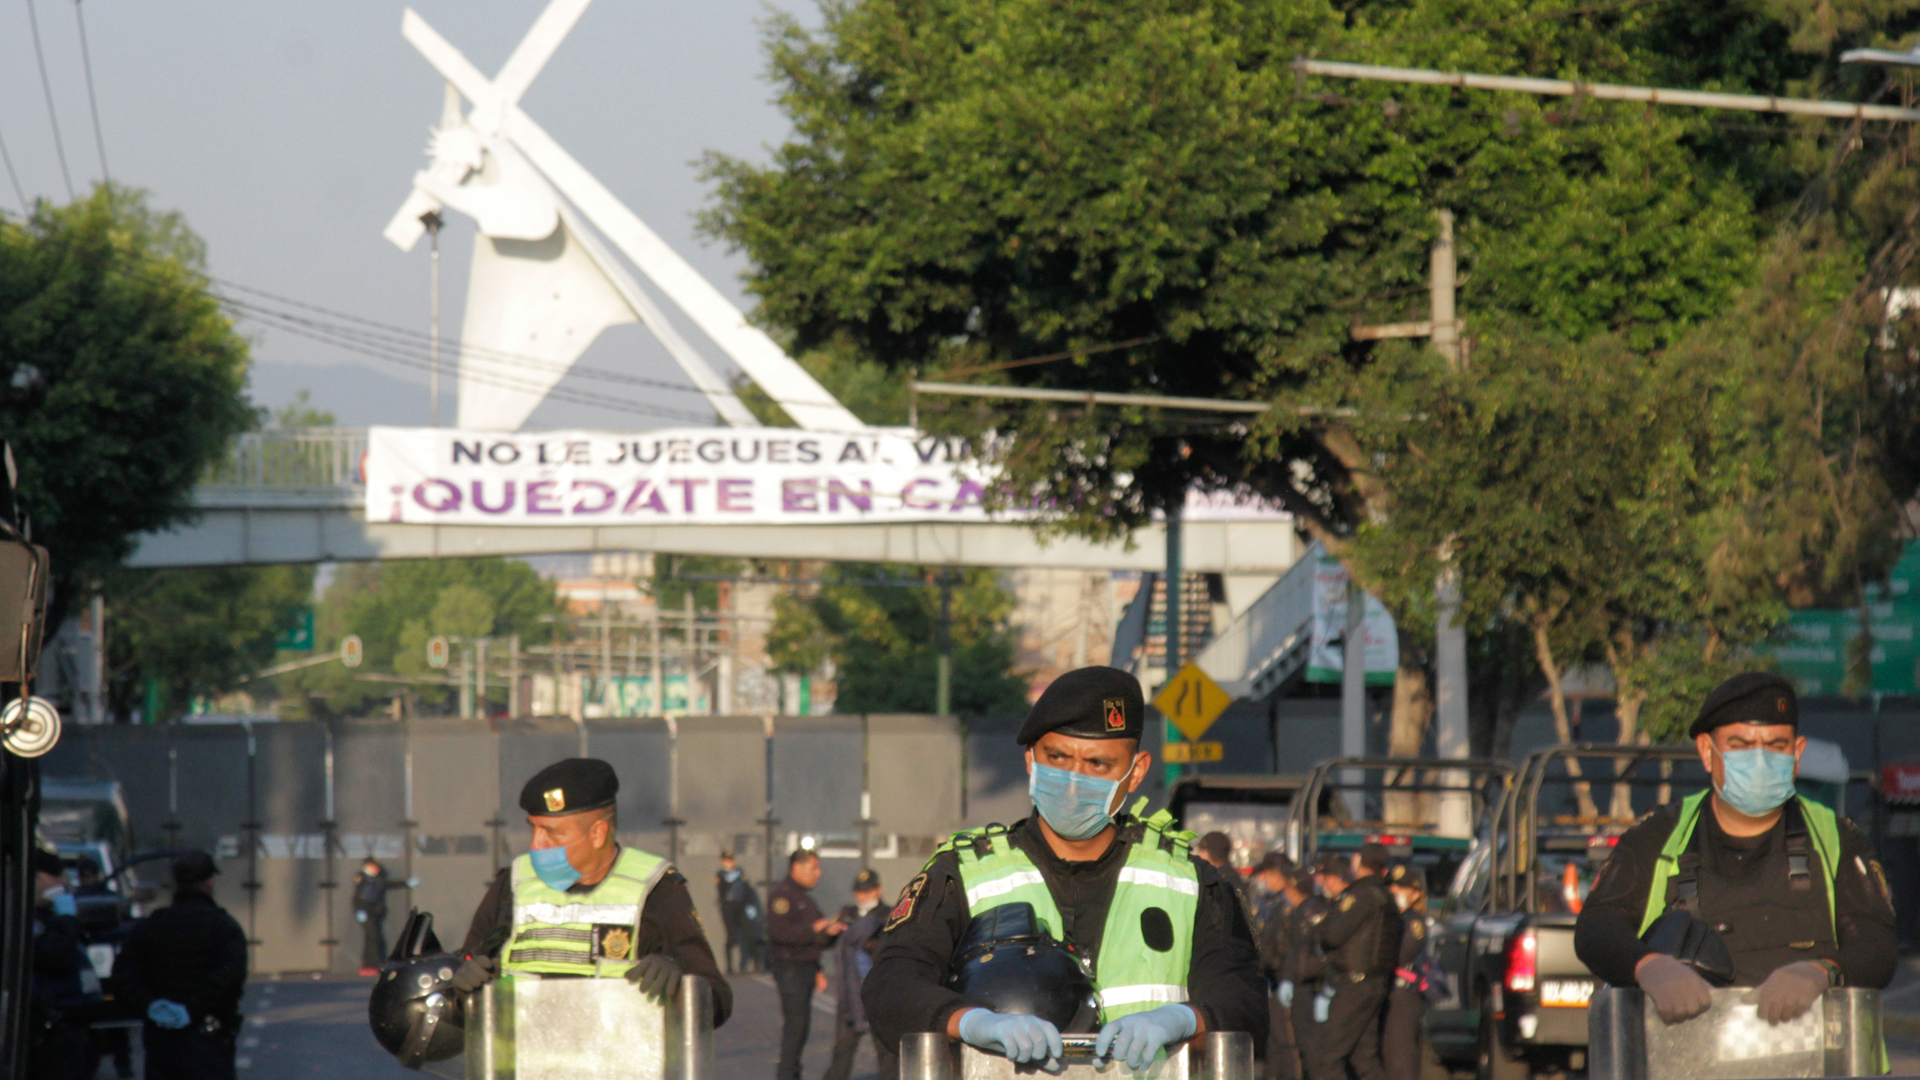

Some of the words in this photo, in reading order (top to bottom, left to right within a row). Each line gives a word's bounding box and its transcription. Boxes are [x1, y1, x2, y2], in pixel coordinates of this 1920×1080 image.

[452, 441, 521, 464] NO
[606, 439, 821, 464] JUEGUES
[782, 478, 872, 513] EN
